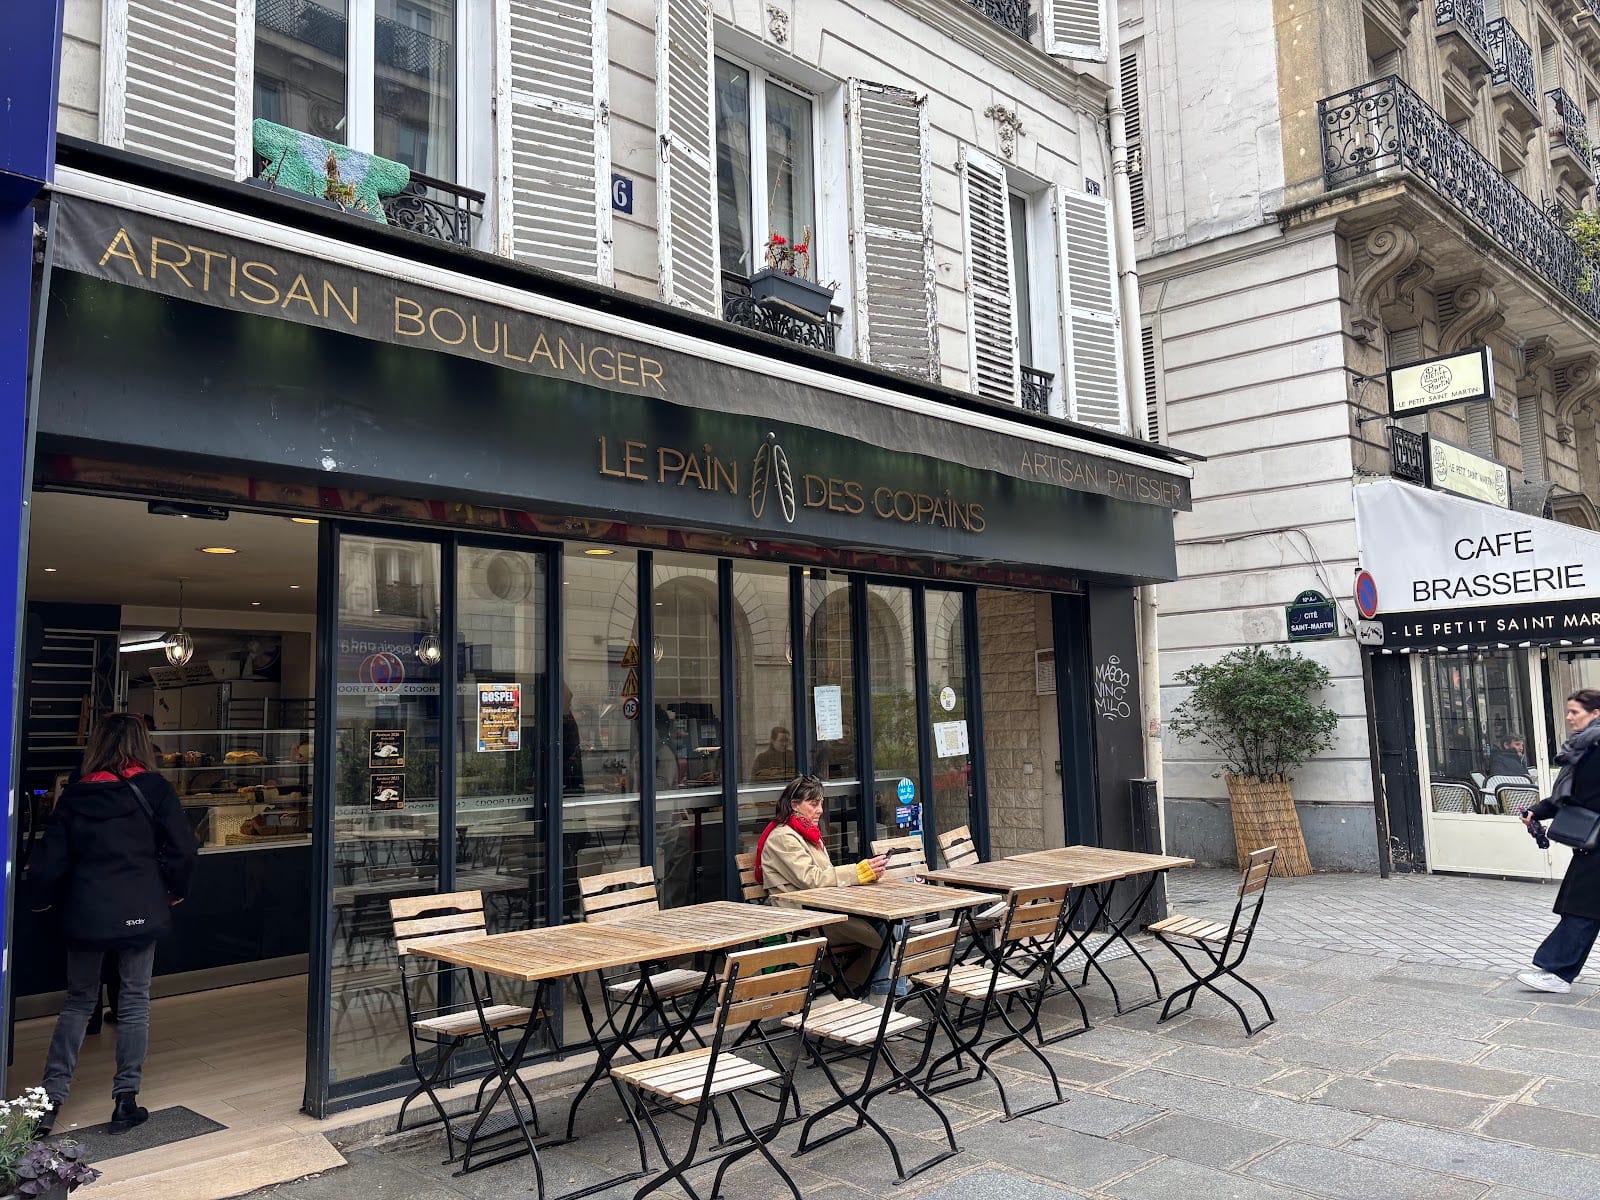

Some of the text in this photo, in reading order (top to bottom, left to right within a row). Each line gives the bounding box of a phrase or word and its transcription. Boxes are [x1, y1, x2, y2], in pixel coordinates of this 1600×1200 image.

[613, 180, 627, 207] 6
[98, 227, 667, 392] ARTISAN BOULANGER
[1408, 397, 1425, 406] PETIT
[1428, 393, 1448, 402] SAINT
[1451, 386, 1478, 398] MARTIN
[601, 435, 648, 481] LE
[804, 473, 865, 514] DES
[1020, 451, 1182, 504] ARTISAN PATISSIER
[1454, 530, 1534, 561] CAFE
[1413, 564, 1586, 602] BRASSERIE
[1291, 621, 1334, 631] SAINT-MARTIN
[1303, 610, 1319, 620] CITÉ
[1404, 624, 1424, 637] LE
[1433, 620, 1487, 636] PETIT
[1497, 615, 1555, 631] SAINT
[338, 685, 360, 693] OOR
[481, 691, 516, 702] GOSPEL
[1094, 698, 1131, 718] MILO
